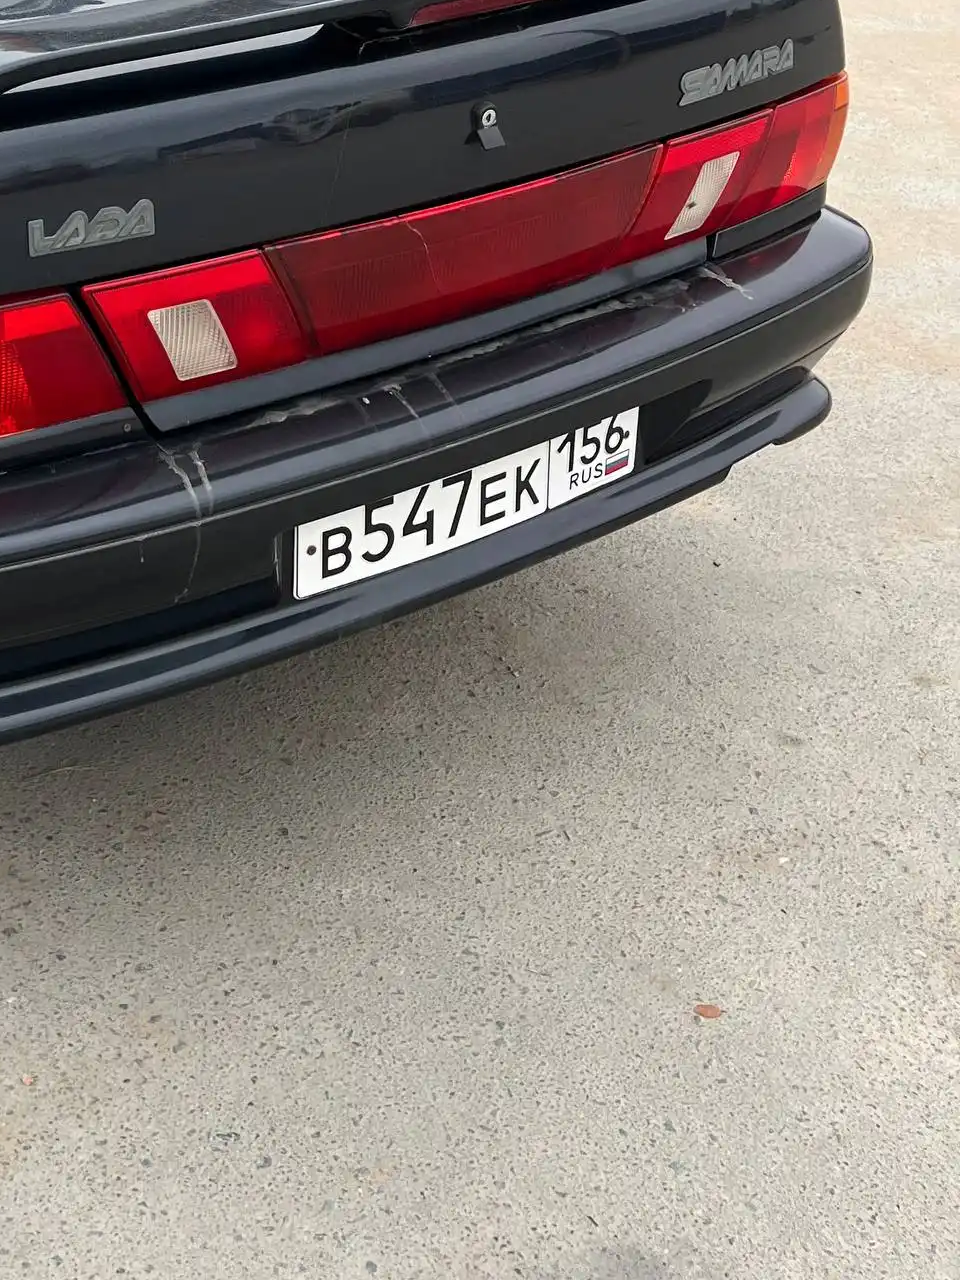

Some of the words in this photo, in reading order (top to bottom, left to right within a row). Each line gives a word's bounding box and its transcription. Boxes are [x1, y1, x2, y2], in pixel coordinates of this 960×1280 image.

[678, 38, 794, 107] SAMARA
[28, 198, 155, 258] LADA
[321, 458, 542, 580] В547ЕК
[557, 413, 623, 473] 156
[569, 461, 604, 491] RUS
